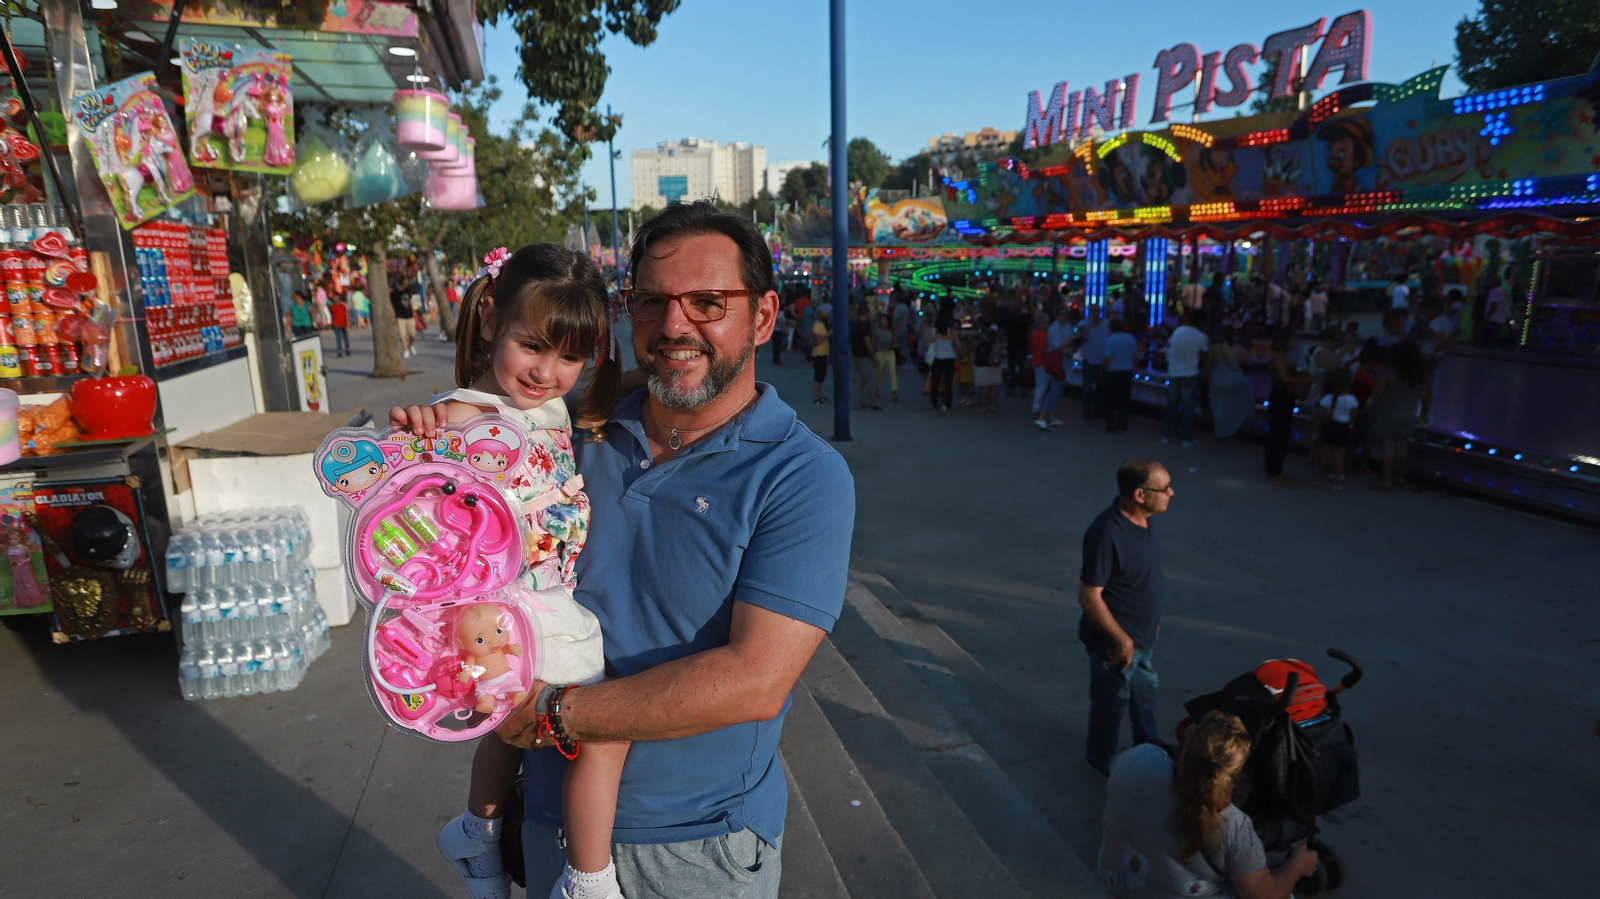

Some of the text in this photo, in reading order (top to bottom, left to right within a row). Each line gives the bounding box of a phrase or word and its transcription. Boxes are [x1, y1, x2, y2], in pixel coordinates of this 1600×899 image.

[1023, 9, 1372, 150] MINI PISTA
[378, 431, 462, 469] DOCTOR
[443, 450, 468, 463] SET
[34, 491, 105, 505] GLADIATOR
